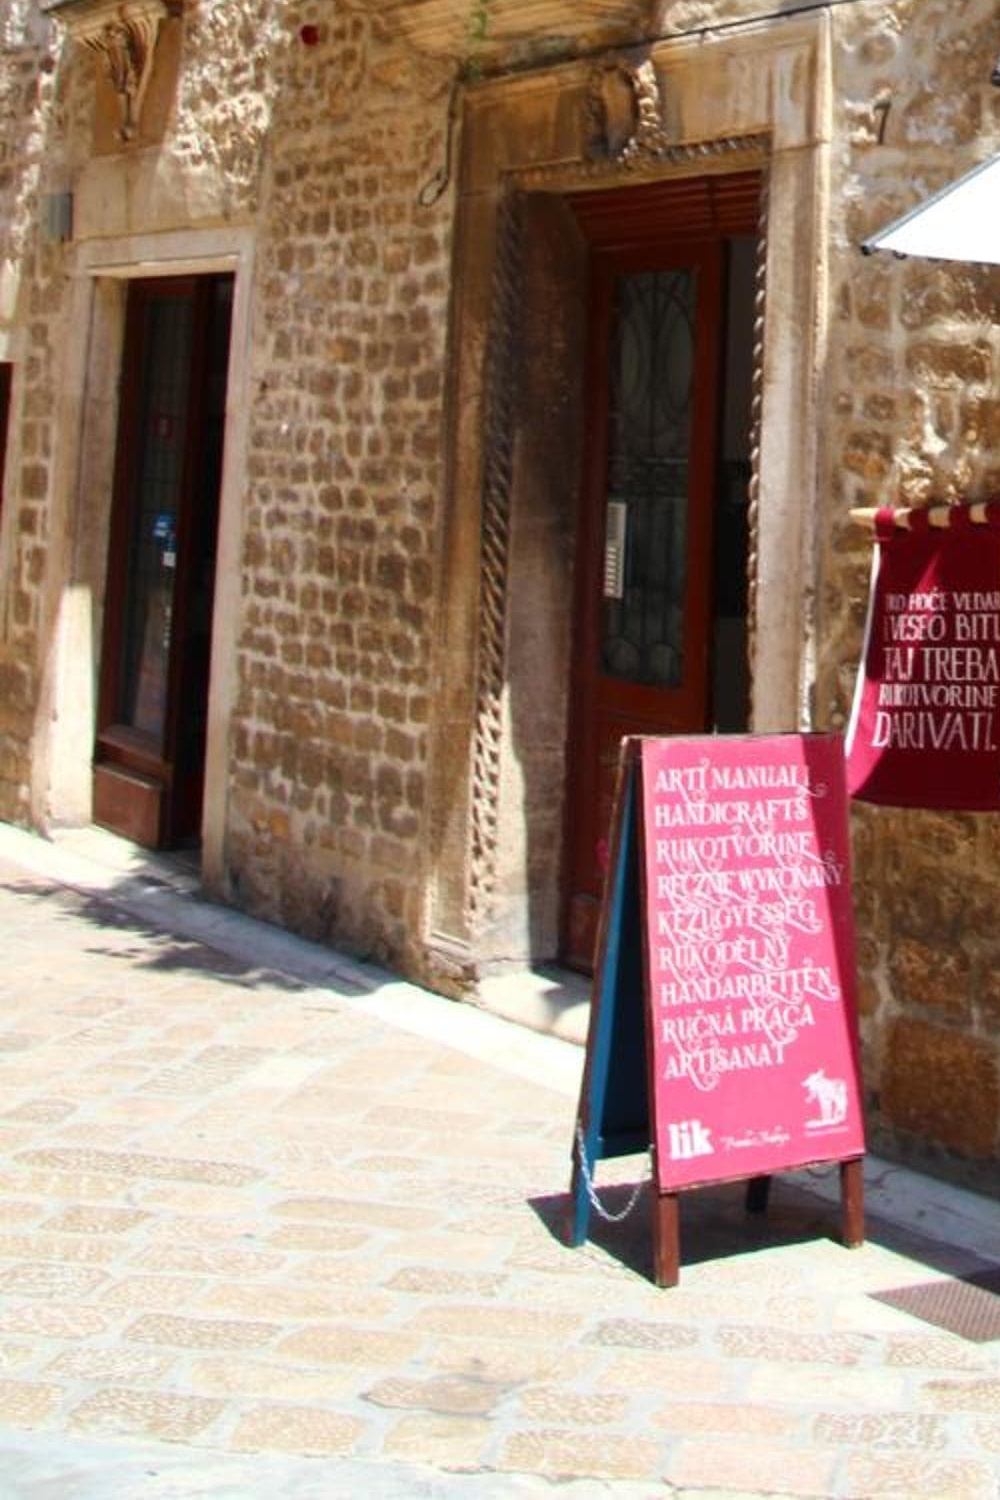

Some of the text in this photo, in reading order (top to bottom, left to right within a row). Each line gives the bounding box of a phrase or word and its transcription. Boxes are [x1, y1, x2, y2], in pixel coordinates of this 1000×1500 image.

[890, 612, 947, 642] VESEO
[882, 645, 1000, 682] TAJ TREBA
[654, 758, 710, 795] ARTI
[655, 797, 810, 828] HANDICRAFTS
[656, 831, 820, 864] RUKOTVORINE
[738, 863, 845, 892] WYKONANY
[660, 963, 835, 1007] HANDARBEITEN
[663, 1041, 788, 1084] ARTISANAT
